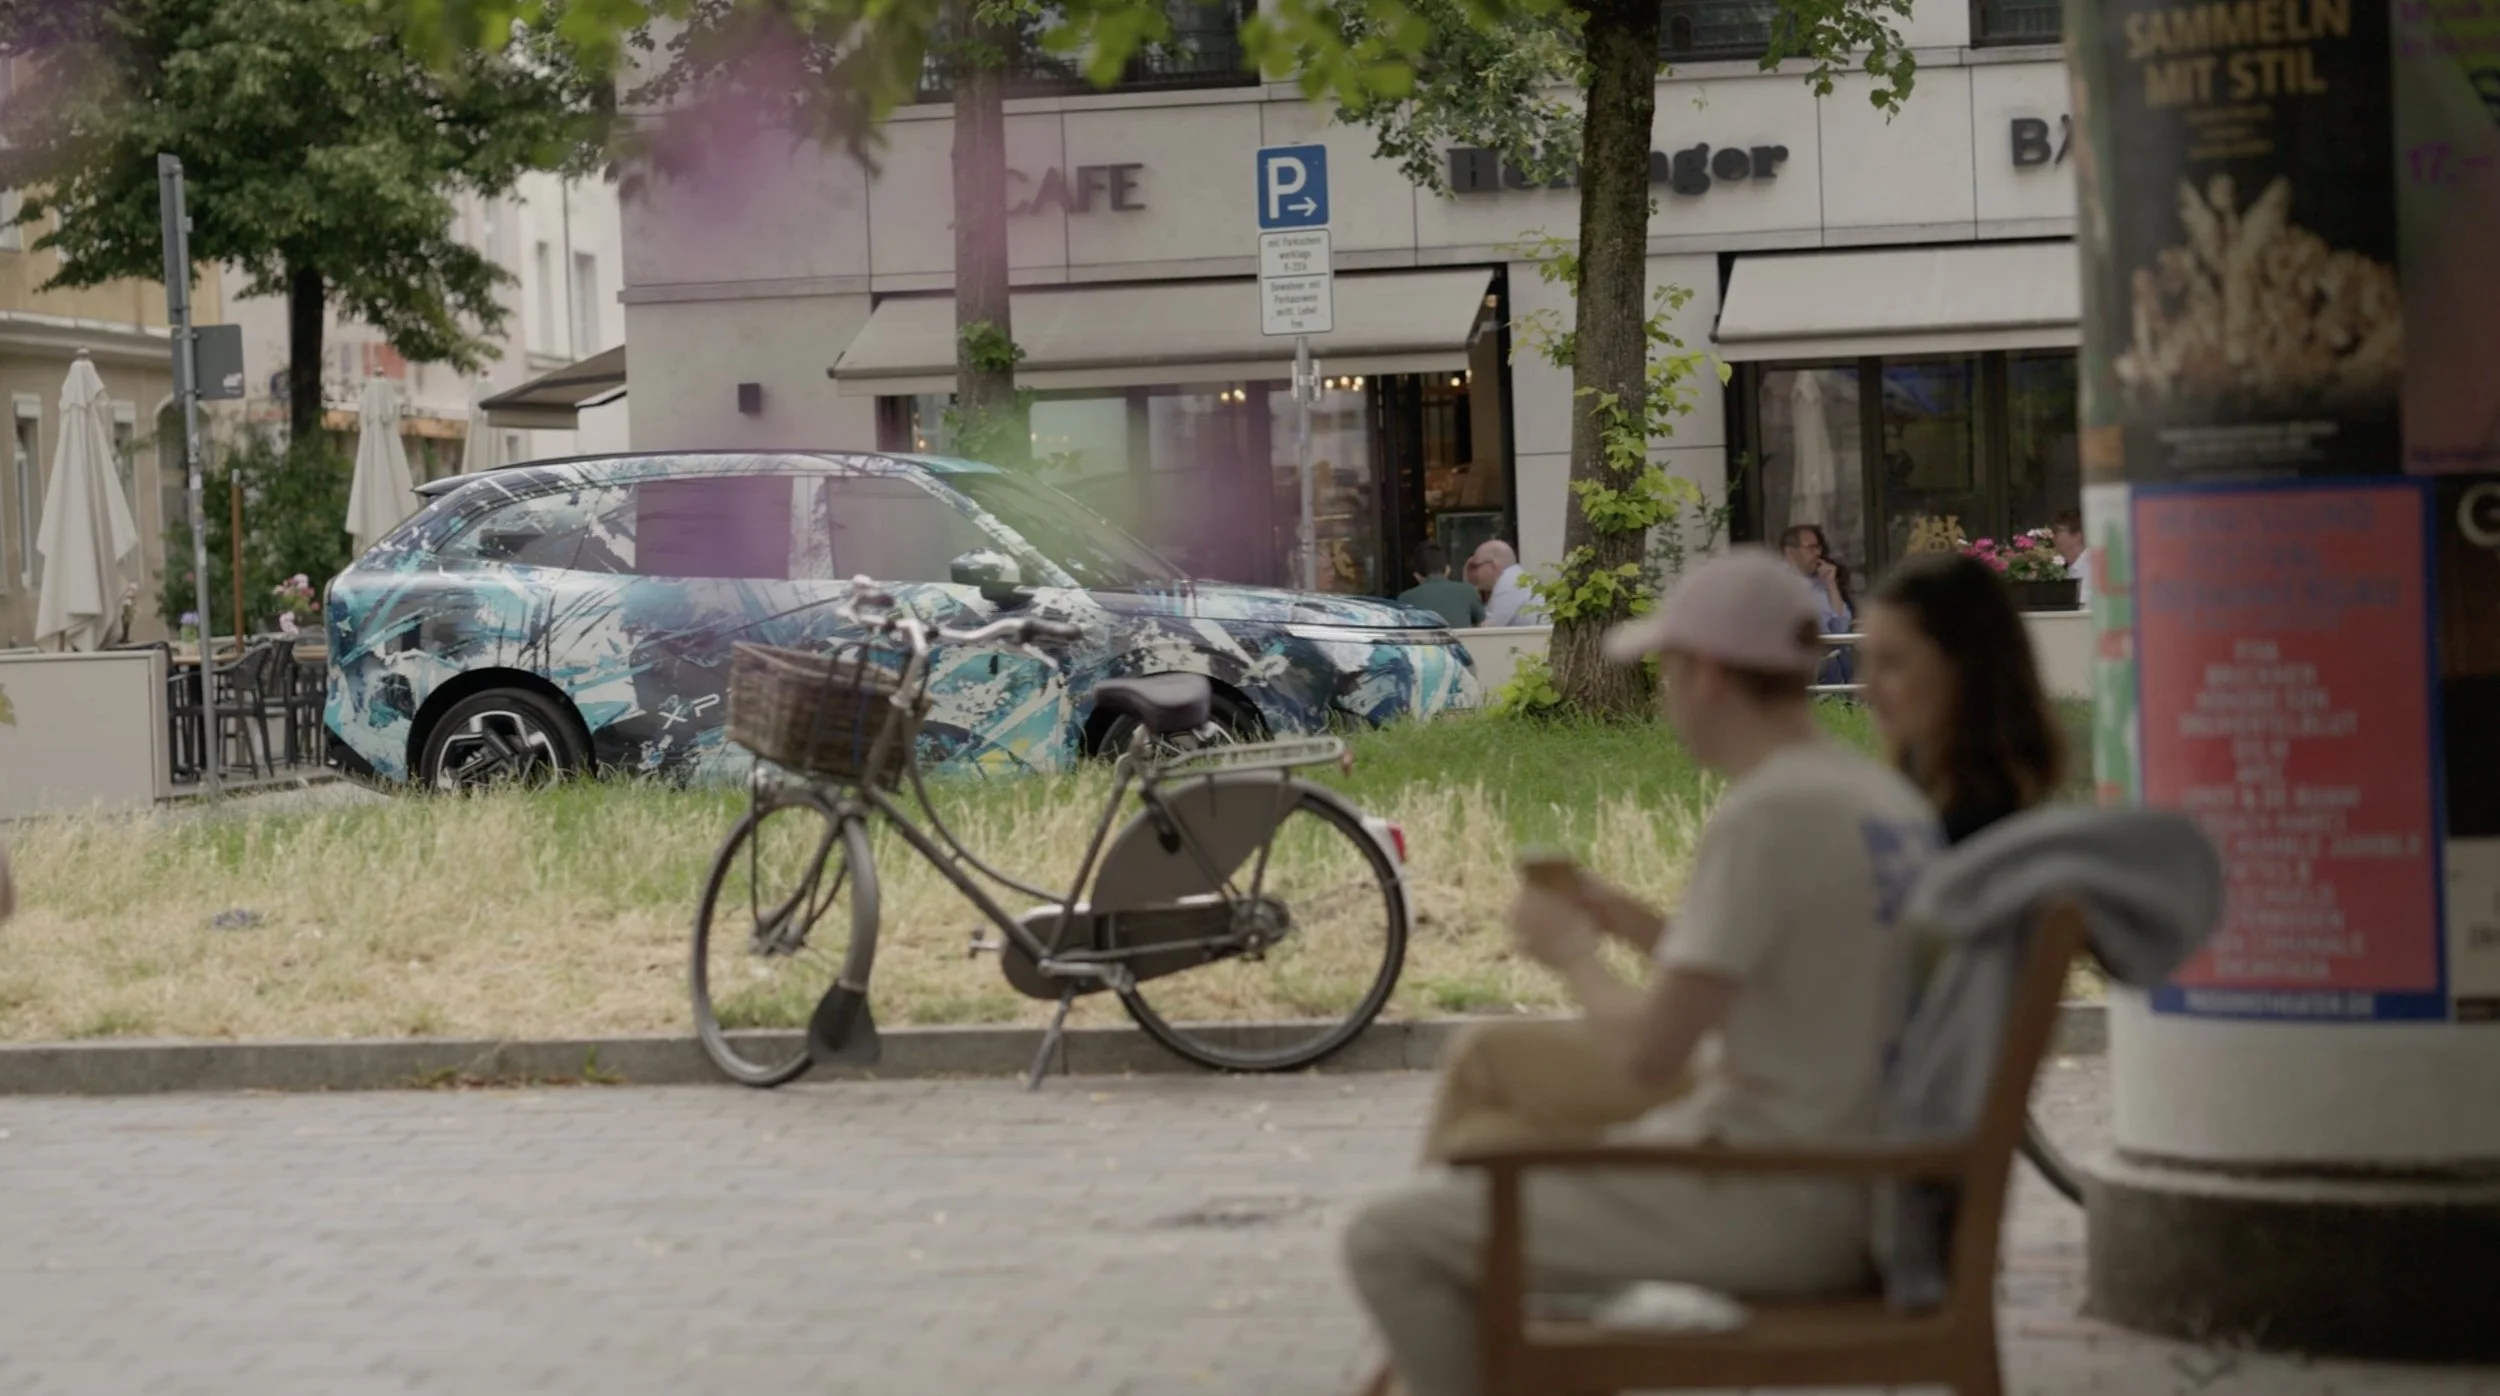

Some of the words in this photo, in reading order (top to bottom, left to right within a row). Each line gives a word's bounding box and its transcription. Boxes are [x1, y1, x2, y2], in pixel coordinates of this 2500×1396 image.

[2125, 0, 2351, 62] SAMMELN
[2144, 56, 2218, 110] MIT
[2227, 47, 2330, 101] STIL
[1267, 156, 1307, 219] P
